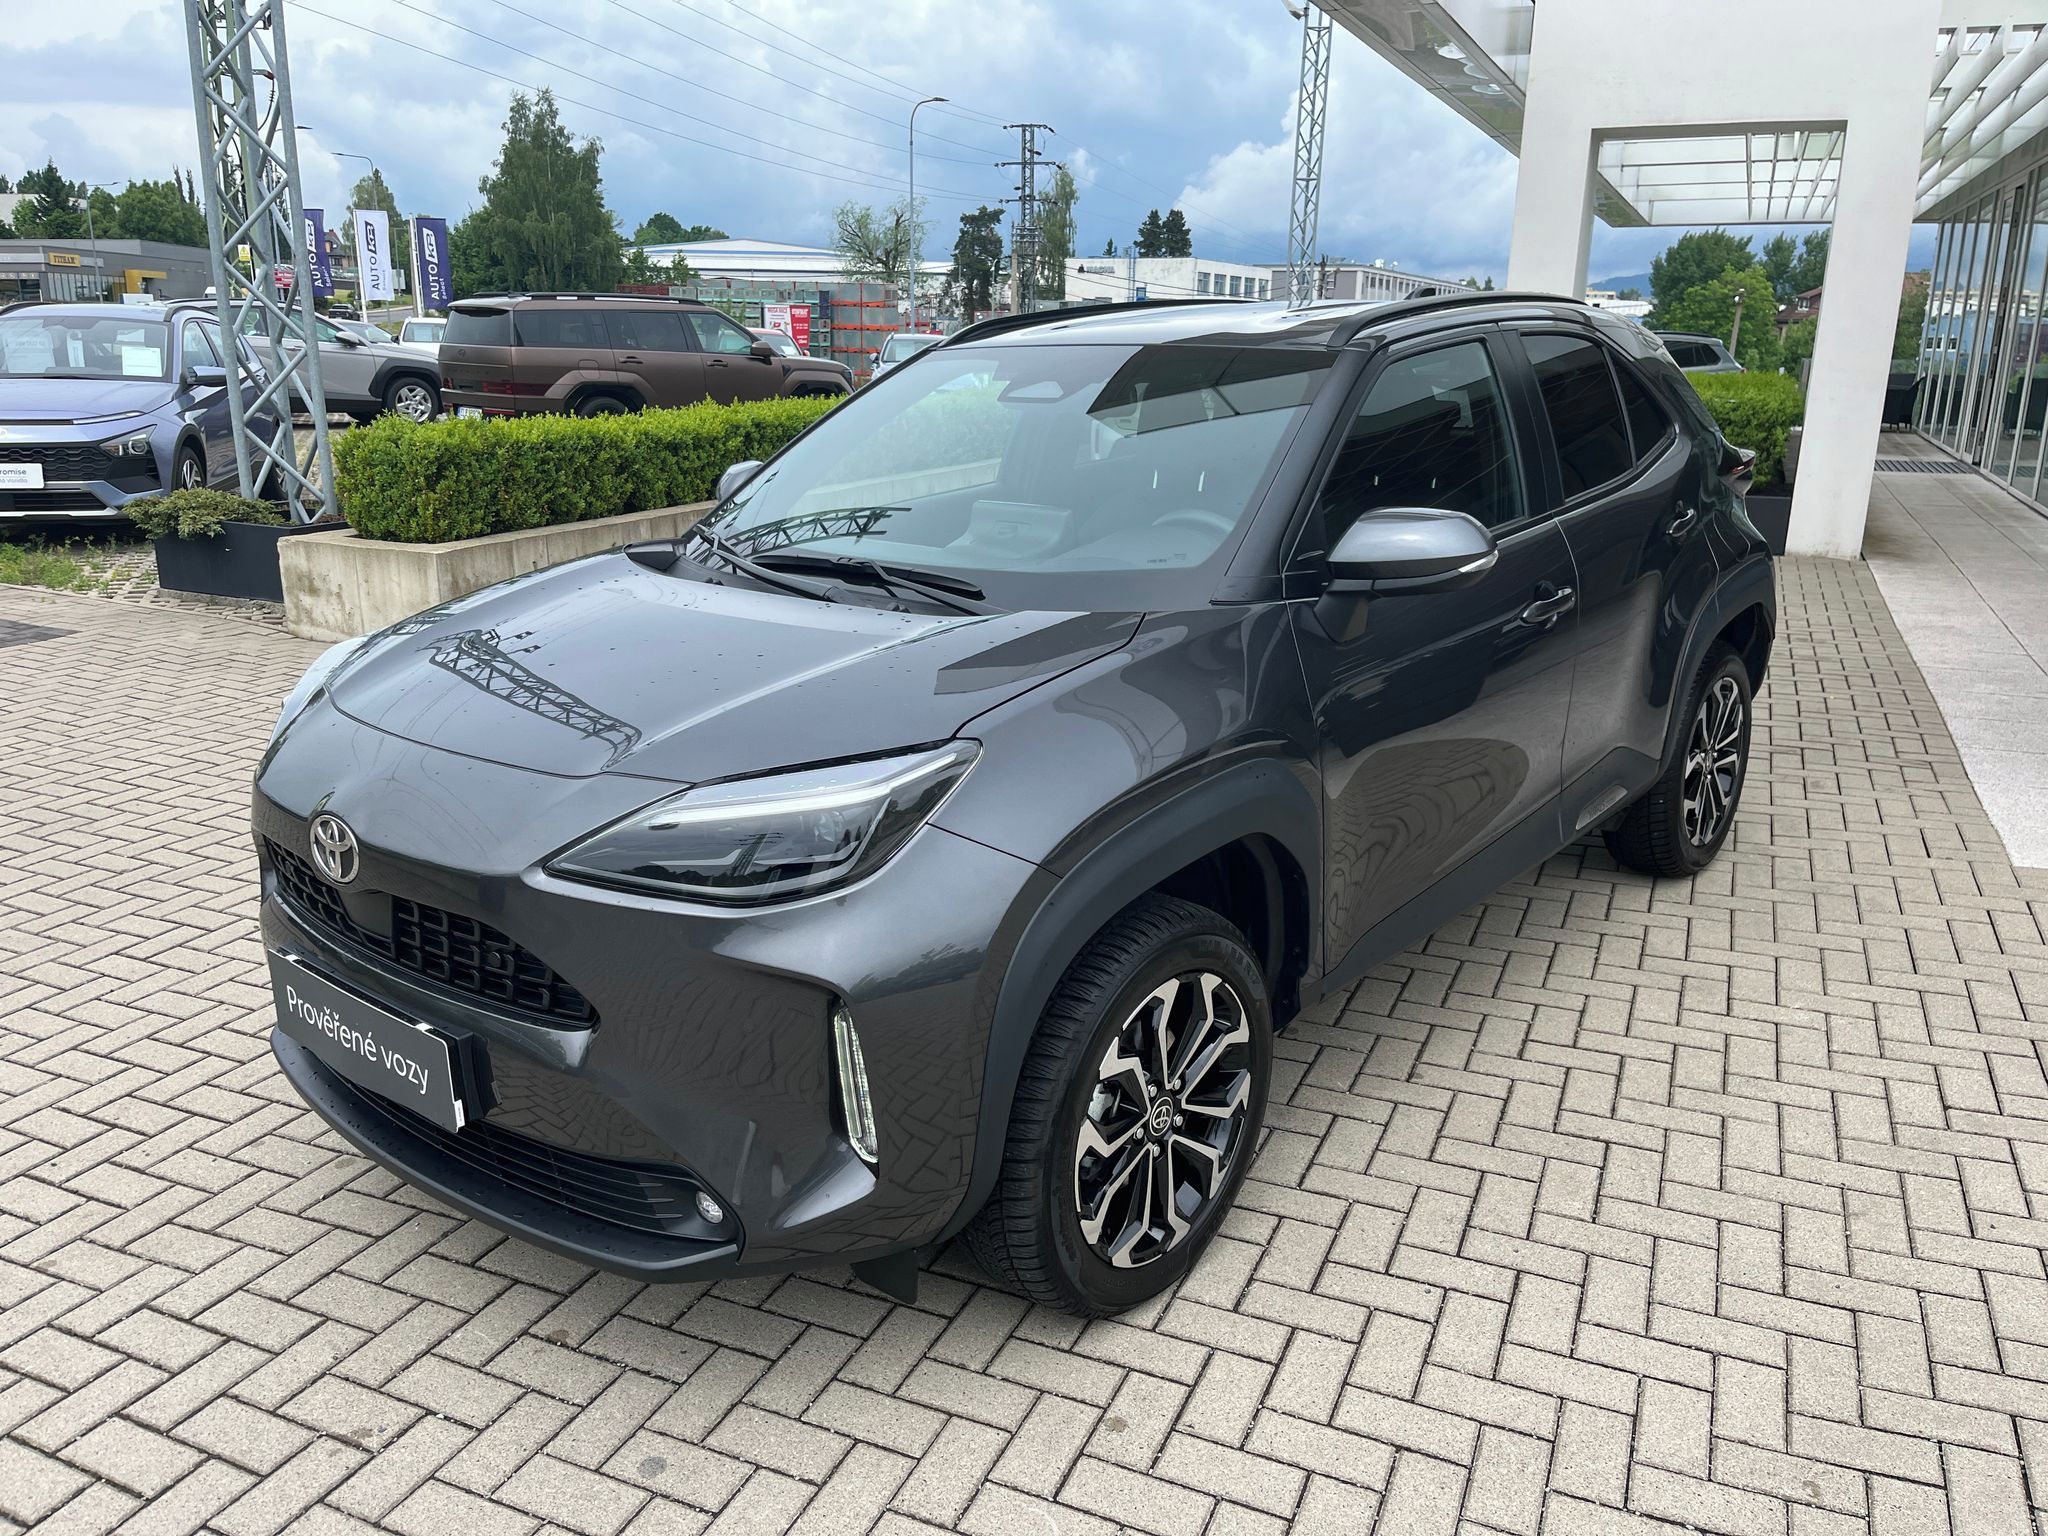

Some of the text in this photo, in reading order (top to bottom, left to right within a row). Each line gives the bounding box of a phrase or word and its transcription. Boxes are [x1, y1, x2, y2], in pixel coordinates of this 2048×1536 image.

[308, 253, 323, 287] AUTO
[369, 256, 380, 290] AUTO
[428, 264, 440, 300] AUTO
[286, 984, 429, 1095] Prověřené vozy
